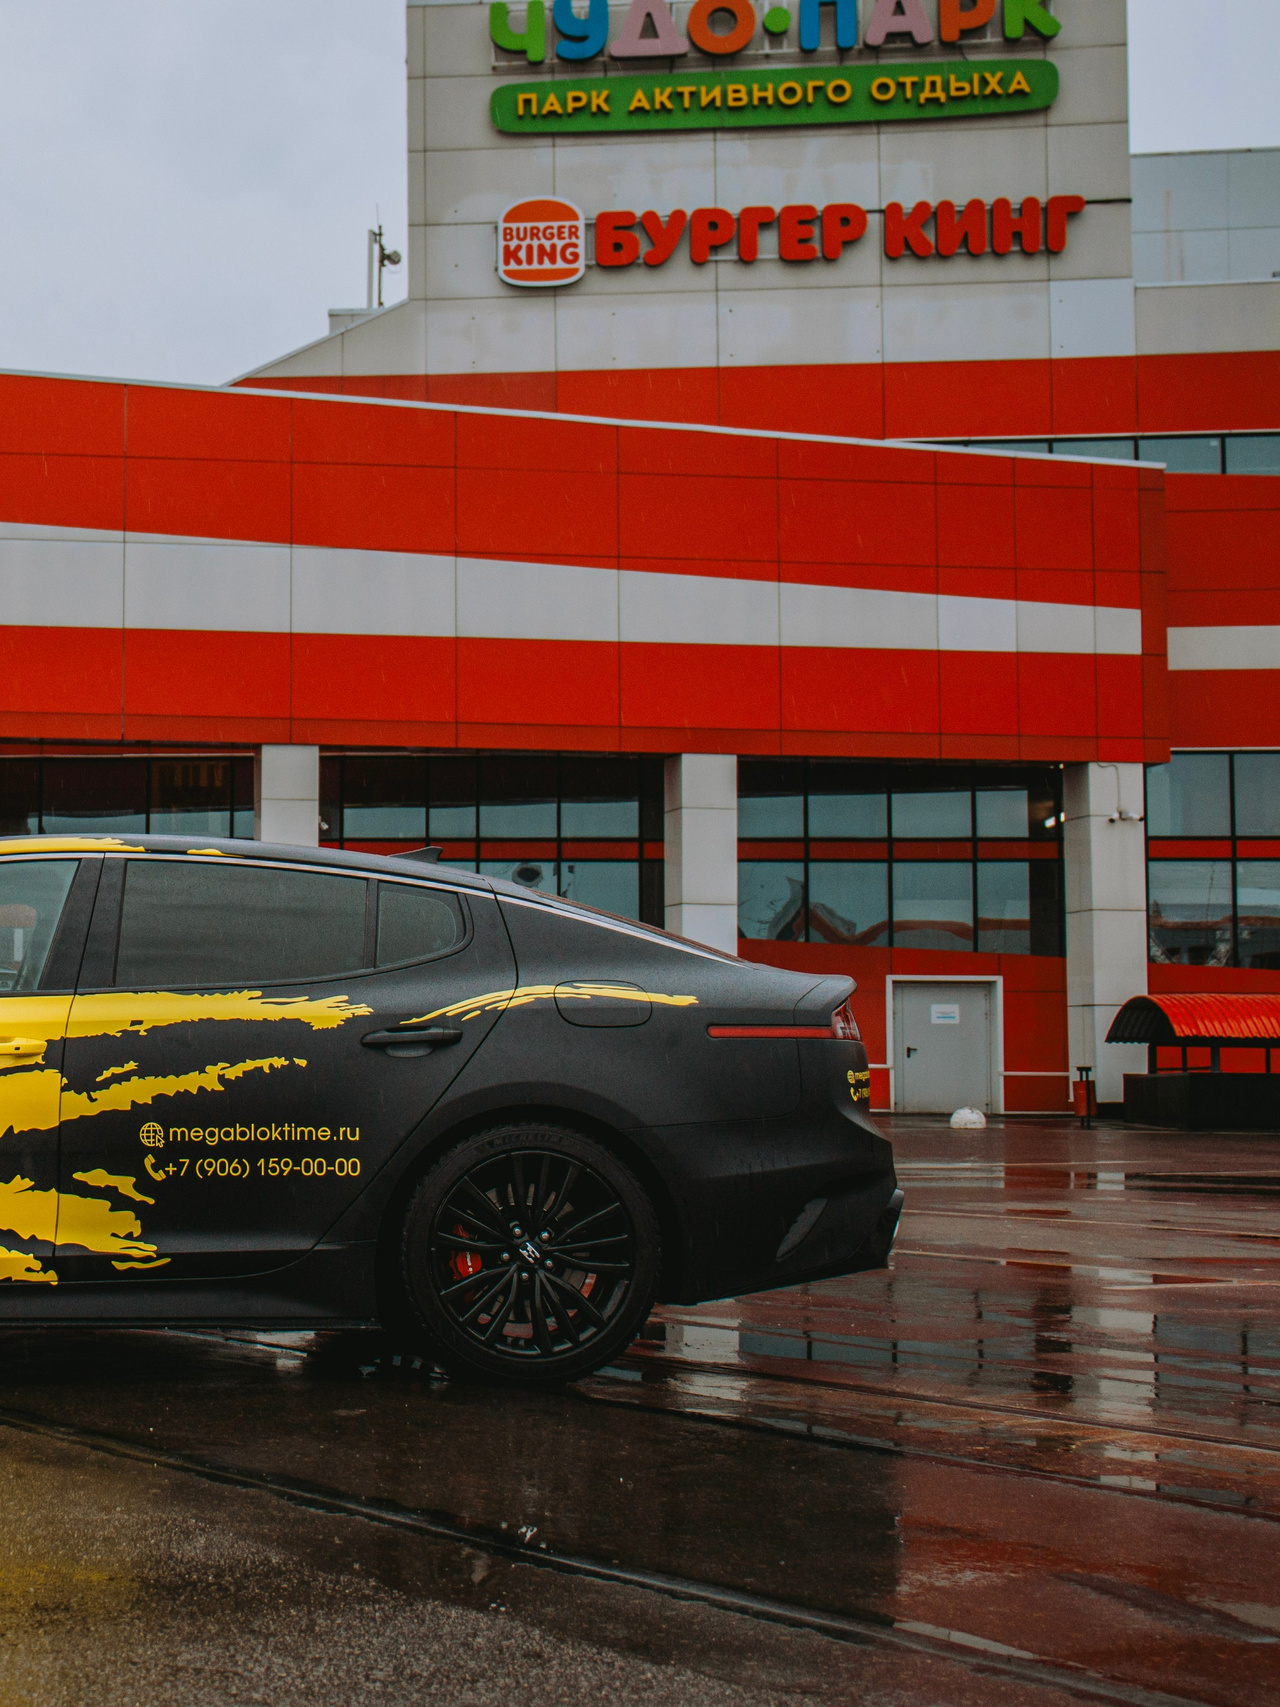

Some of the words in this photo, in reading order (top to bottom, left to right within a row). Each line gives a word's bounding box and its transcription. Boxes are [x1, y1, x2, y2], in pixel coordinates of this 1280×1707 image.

[517, 90, 610, 116] ПАРК
[628, 79, 852, 112] АКТИВНОГО
[871, 70, 1031, 104] ОТДЫХА
[503, 225, 580, 242] BURGER
[594, 202, 867, 267] БУРГЕР
[883, 194, 1086, 259] КИНГ
[503, 242, 580, 266] KING
[169, 1123, 360, 1146] megabloktime.ru
[164, 1158, 189, 1176] +7
[195, 1158, 250, 1179] (906)
[257, 1158, 361, 1177] 159-00-00
